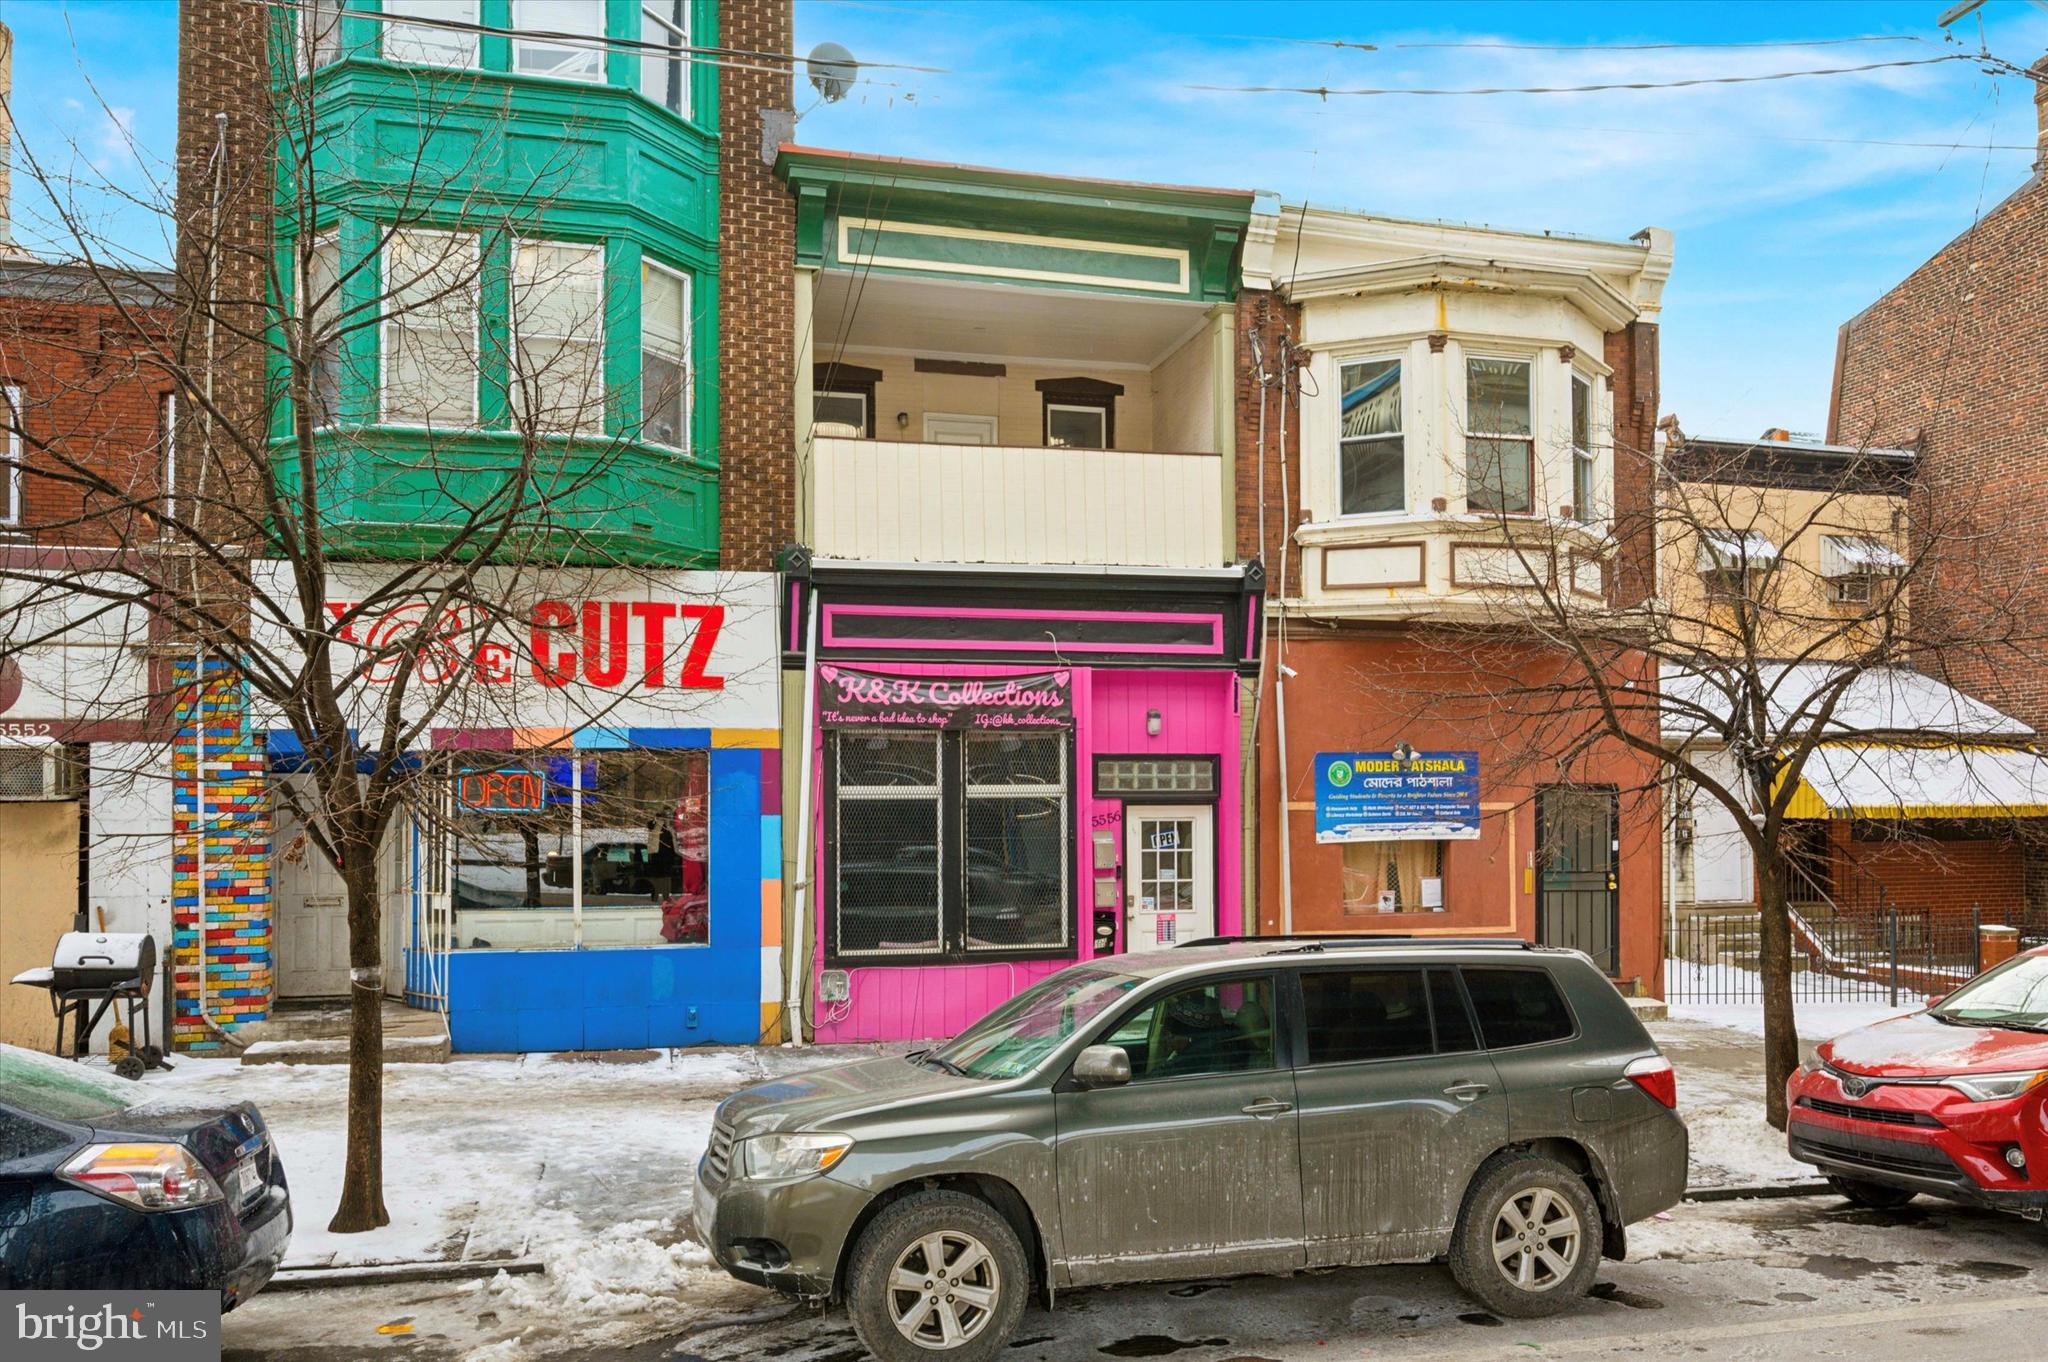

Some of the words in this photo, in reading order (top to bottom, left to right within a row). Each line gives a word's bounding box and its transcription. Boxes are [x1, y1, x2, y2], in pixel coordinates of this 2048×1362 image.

[530, 599, 725, 690] CUTZ
[837, 676, 925, 706] K&K
[928, 680, 1065, 708] Collections
[845, 714, 871, 723] never
[871, 715, 878, 723] a
[879, 711, 896, 724] bad
[896, 711, 915, 724] idea
[916, 712, 926, 724] to
[1355, 760, 1400, 773] MODER
[1402, 759, 1466, 773] ATSHALA
[462, 771, 543, 808] OPEN
[1091, 810, 1122, 828] 5556
